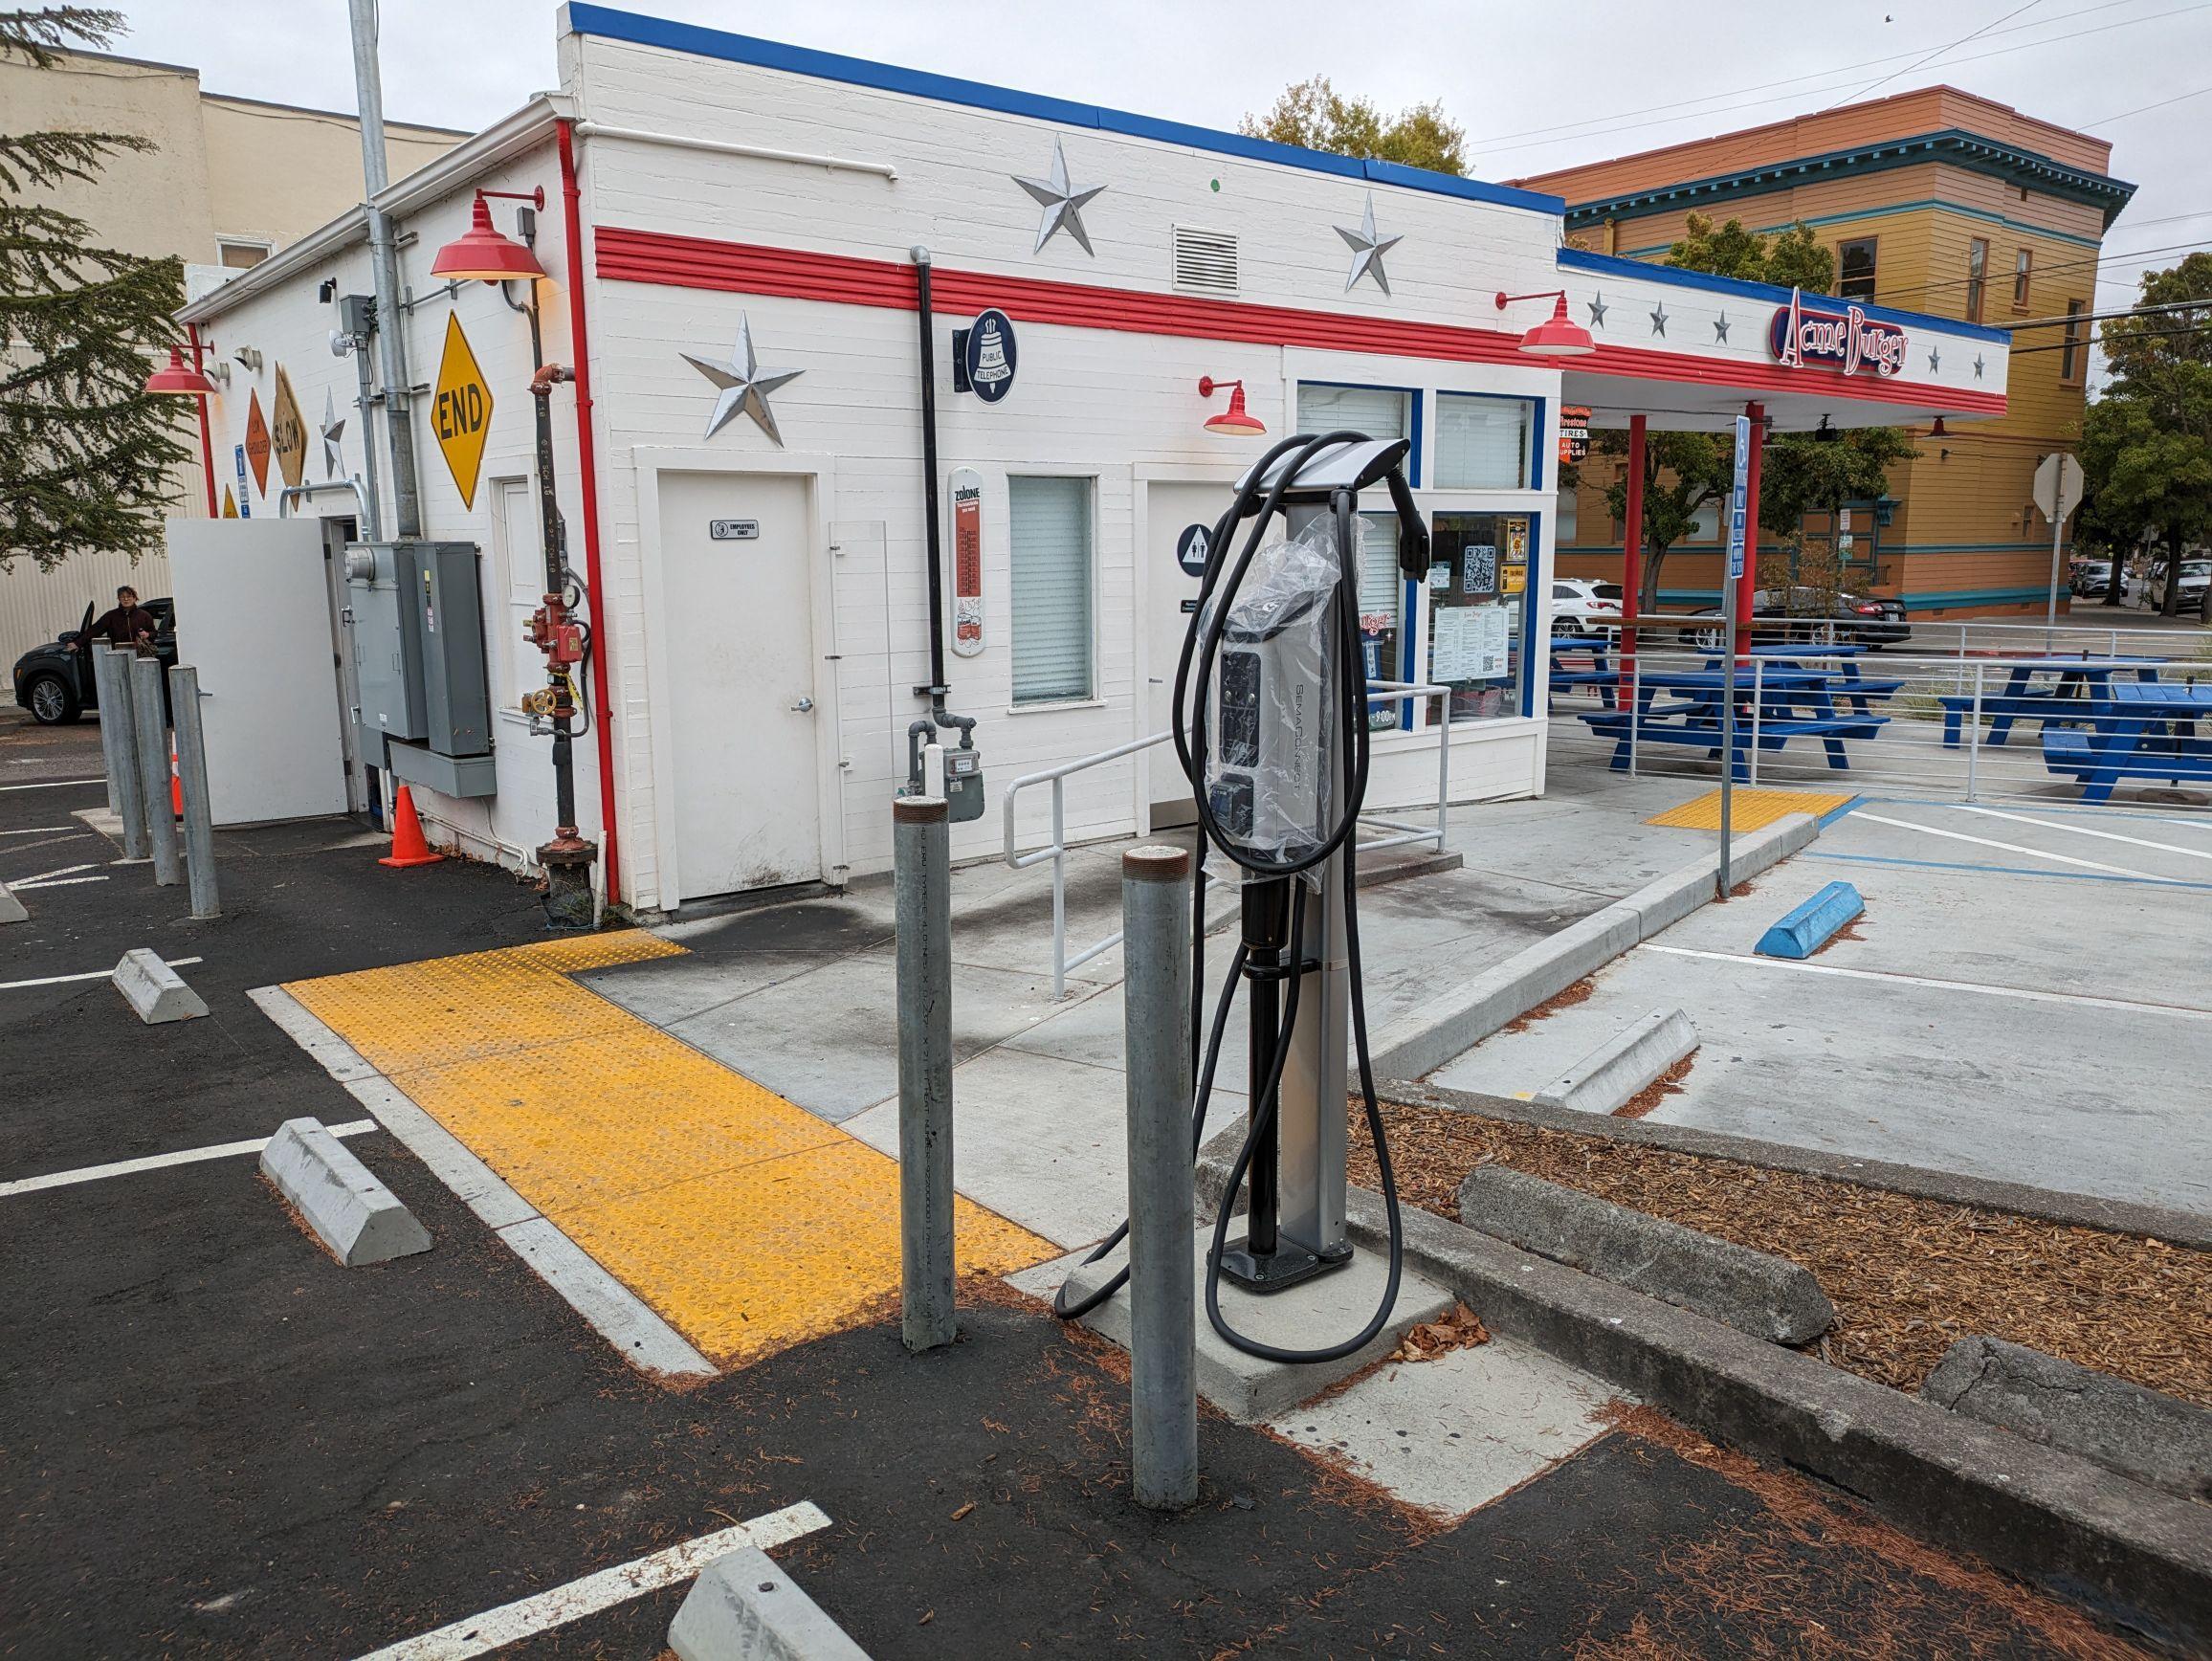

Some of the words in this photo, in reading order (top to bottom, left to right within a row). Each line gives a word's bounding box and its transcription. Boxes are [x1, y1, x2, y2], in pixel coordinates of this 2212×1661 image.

[1779, 286, 1847, 368] Acme
[1844, 306, 1909, 377] Burger
[977, 365, 1009, 380] TELEPHONE
[982, 350, 1002, 363] PUBLIC
[438, 383, 483, 440] END
[1560, 416, 1587, 428] irestone
[274, 418, 299, 454] SLOW
[1294, 683, 1304, 790] SEMACONNECT
